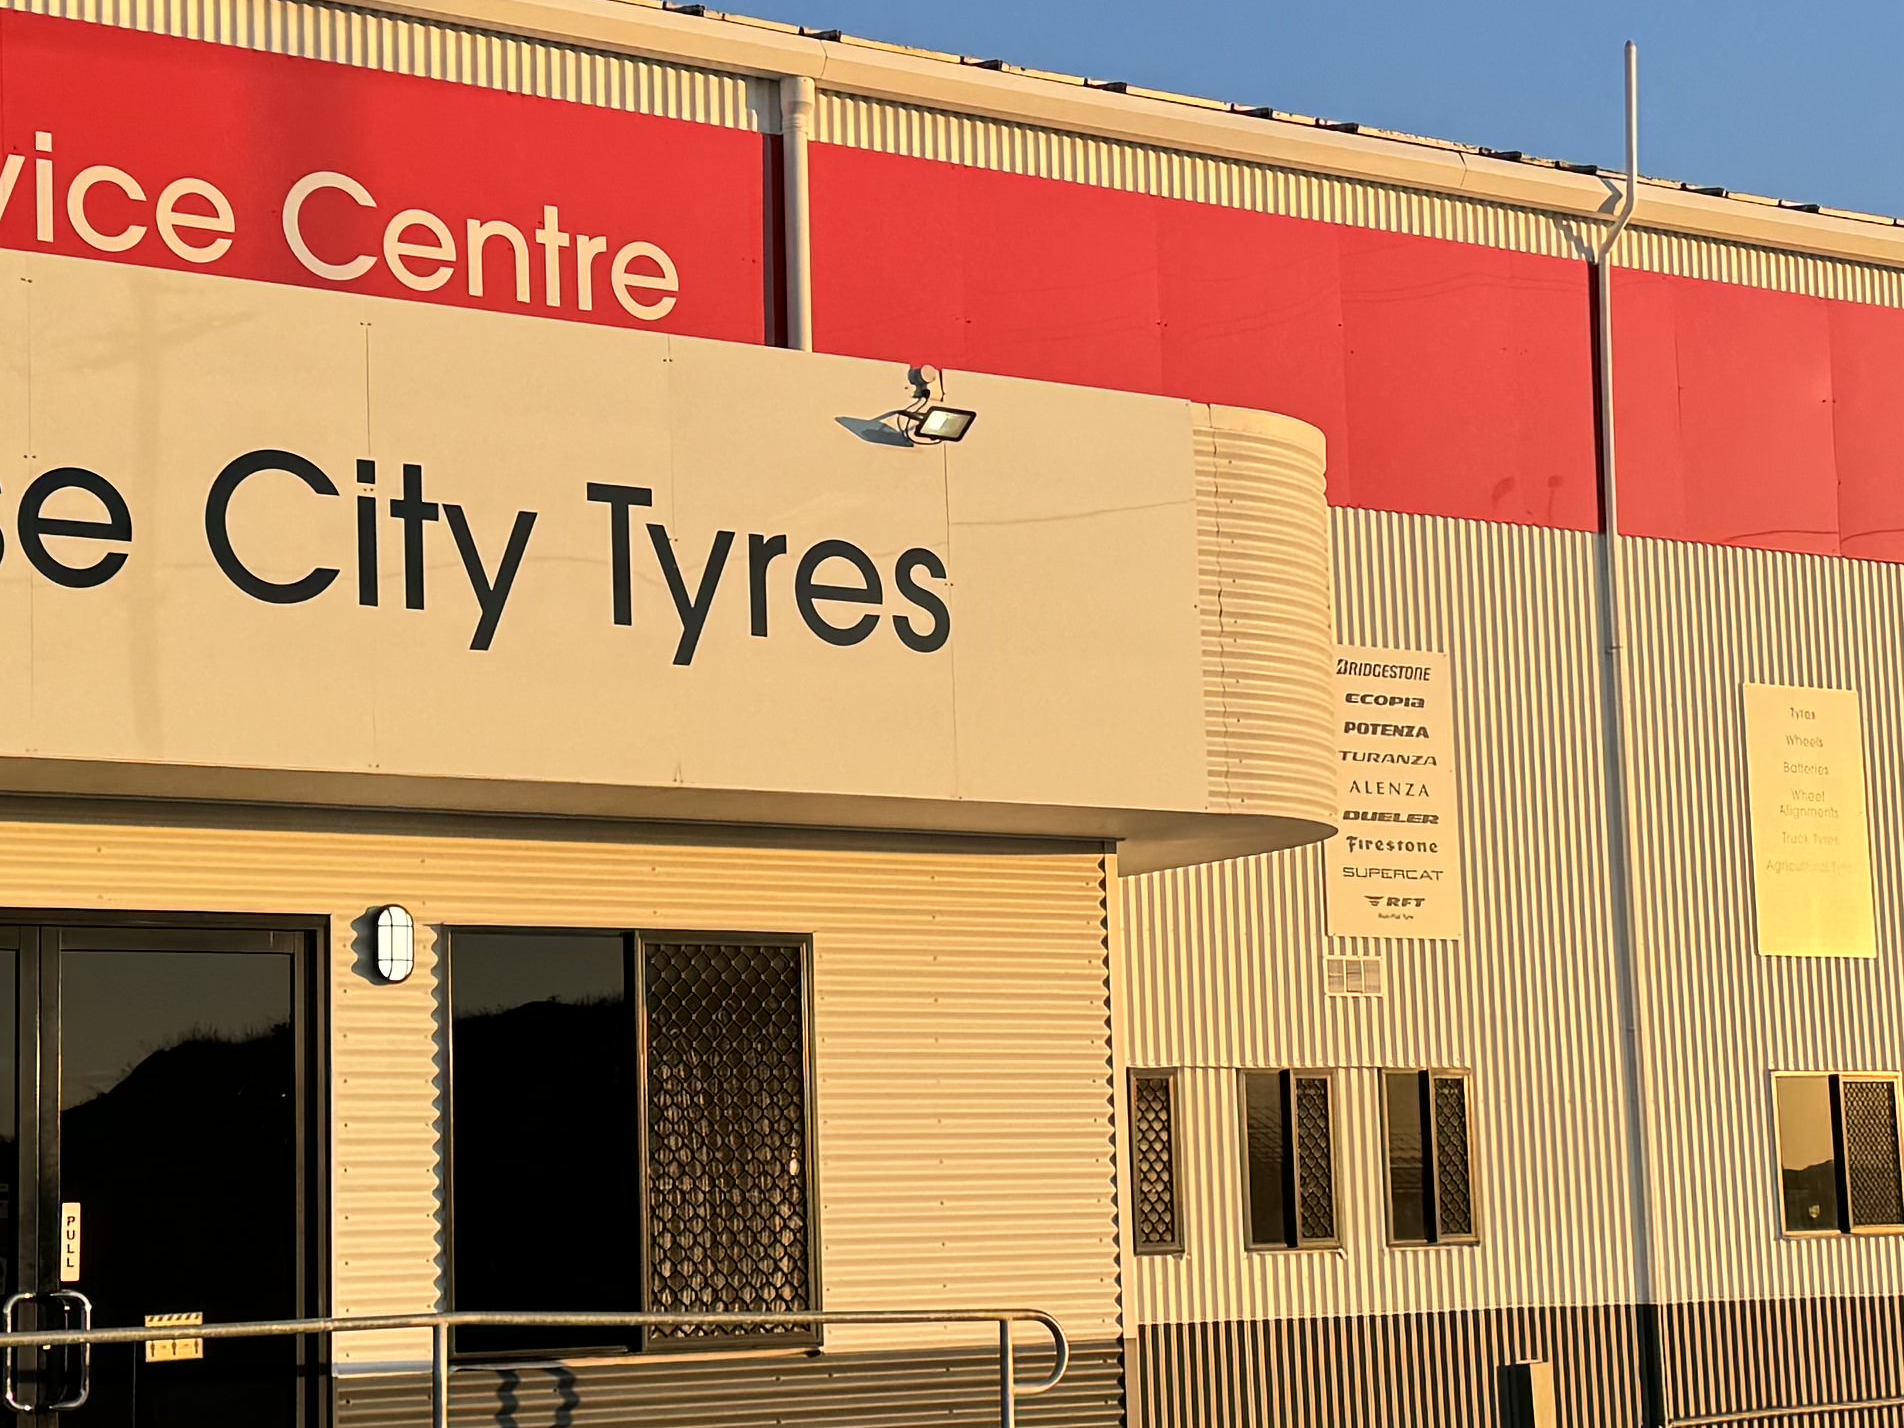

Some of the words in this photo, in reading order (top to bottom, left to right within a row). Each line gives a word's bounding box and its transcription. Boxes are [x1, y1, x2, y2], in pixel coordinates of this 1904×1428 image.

[283, 171, 679, 321] Centre
[205, 449, 538, 651] City
[586, 482, 951, 666] Tyres
[1336, 658, 1431, 681] BRIDGESTONE
[1790, 707, 1816, 721] Tyres
[1344, 721, 1430, 739] POTENZA
[1786, 734, 1824, 748] Wheels
[1338, 750, 1438, 766] TURANZA
[1783, 761, 1829, 776] Batteries
[1350, 780, 1430, 797] ALENZA
[1791, 789, 1825, 803] Wheel
[1343, 810, 1439, 824] DUELER
[1779, 804, 1839, 819] Alignments
[1346, 835, 1438, 853] Firestone
[1343, 866, 1444, 880] SUPERCAT
[1386, 897, 1425, 907] RFT
[66, 1215, 76, 1268] PULL
